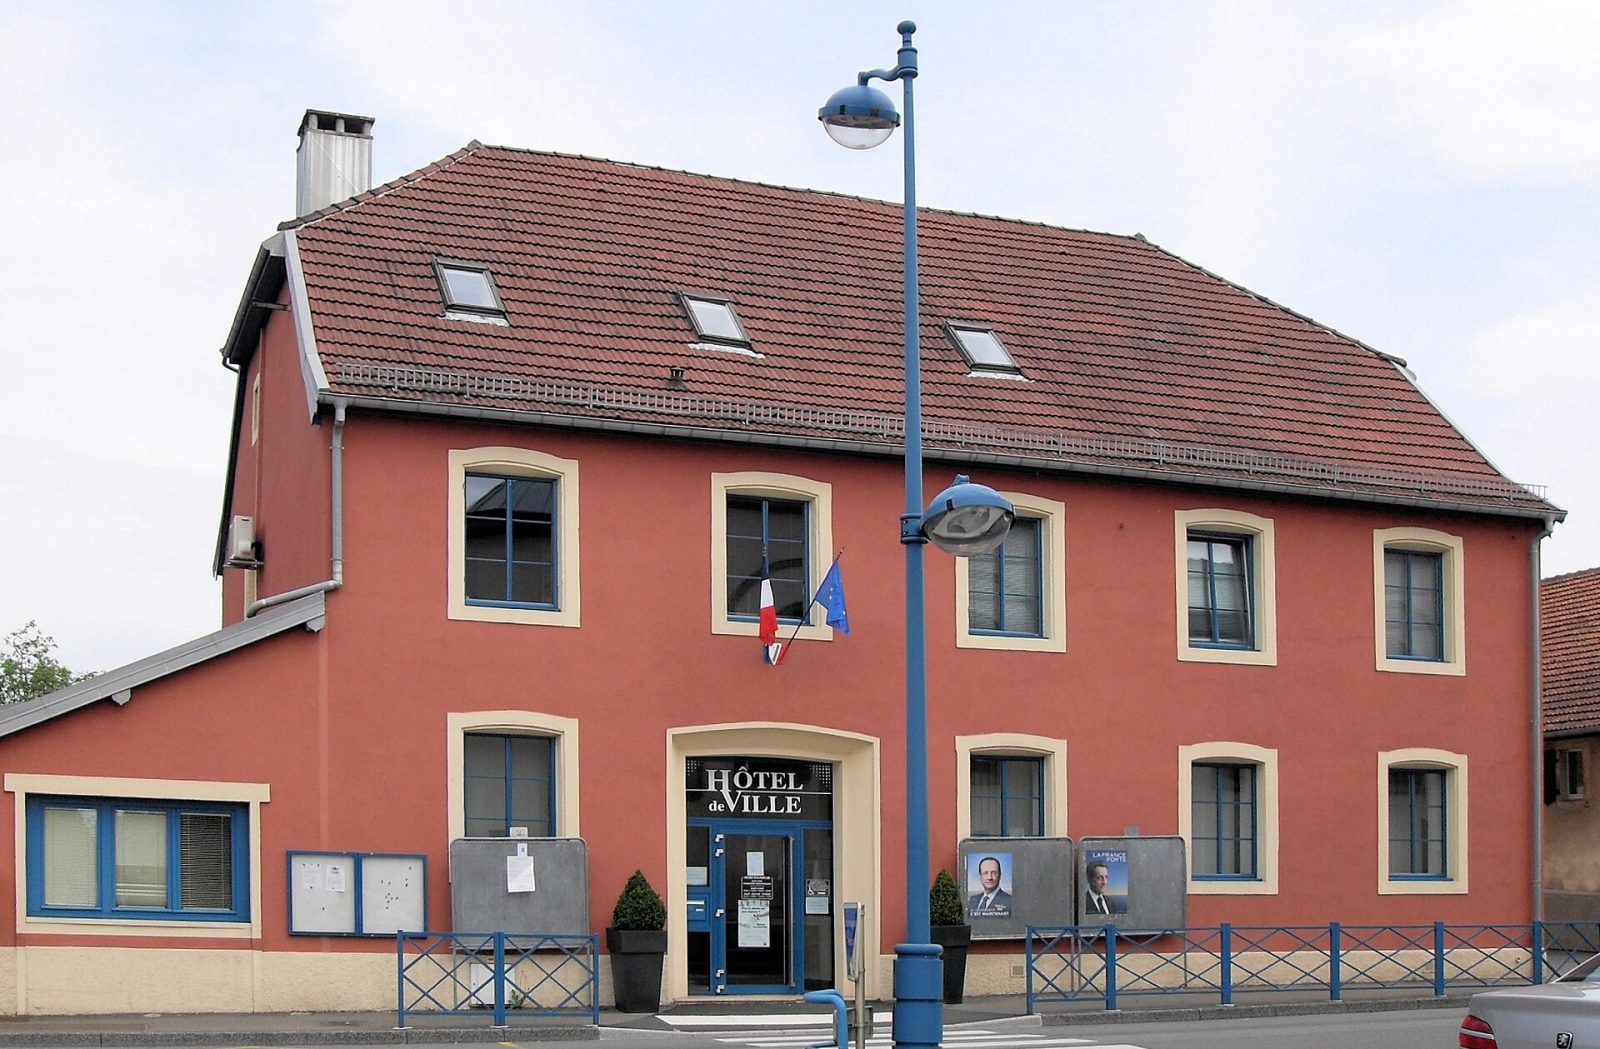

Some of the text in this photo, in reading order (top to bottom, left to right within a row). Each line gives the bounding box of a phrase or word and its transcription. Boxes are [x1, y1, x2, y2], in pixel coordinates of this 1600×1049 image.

[705, 766, 804, 791] HÔTEL
[708, 789, 802, 814] de VILLE
